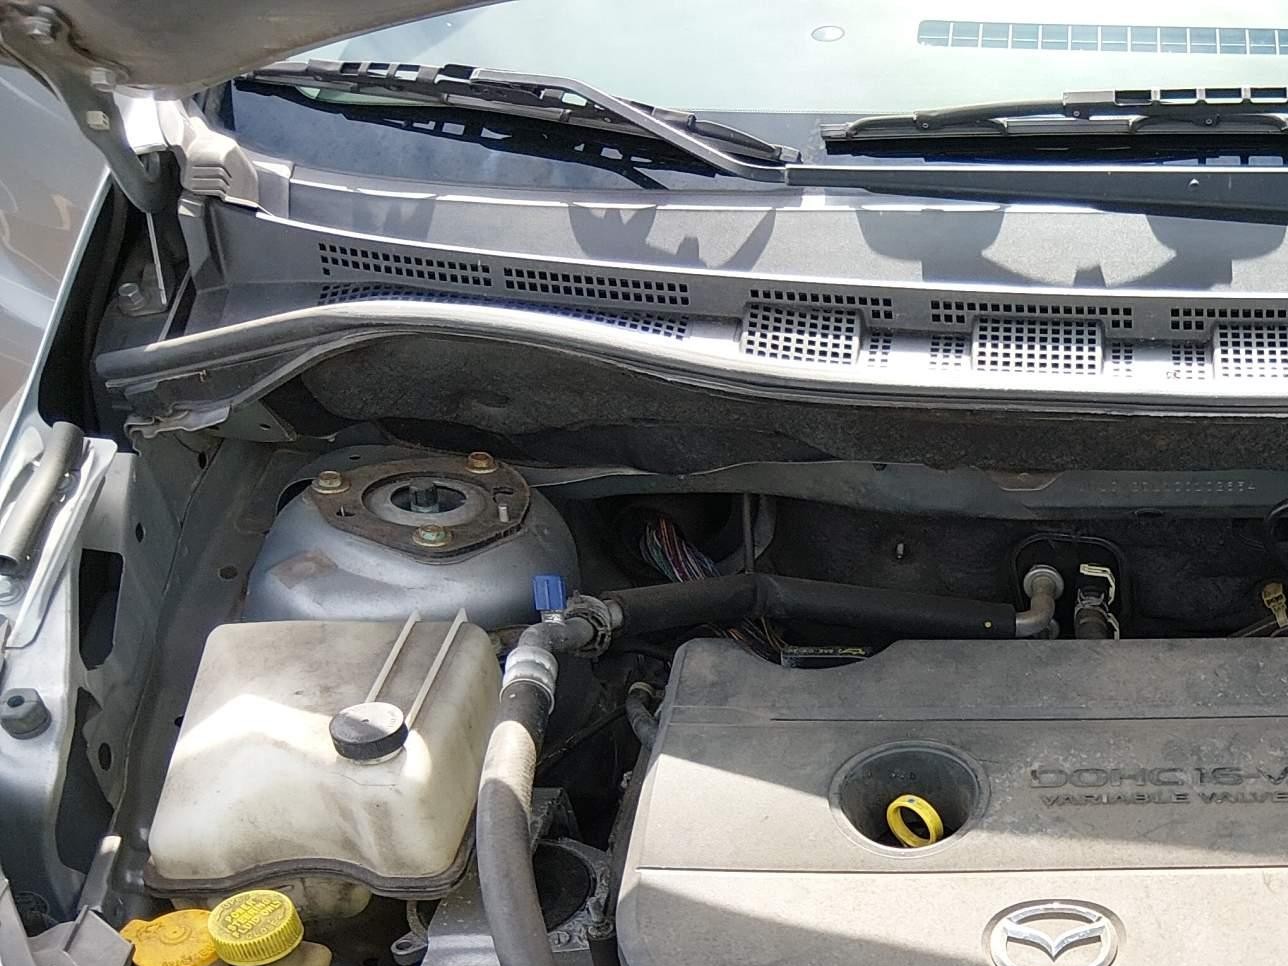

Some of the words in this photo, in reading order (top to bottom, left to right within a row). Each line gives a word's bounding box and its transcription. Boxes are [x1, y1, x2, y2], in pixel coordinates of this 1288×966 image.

[1030, 768, 1183, 789] DOHC
[1040, 791, 1190, 807] VARIABLE
[1200, 791, 1288, 805] VALVE
[225, 896, 257, 922] POWER
[231, 916, 260, 938] FLUID
